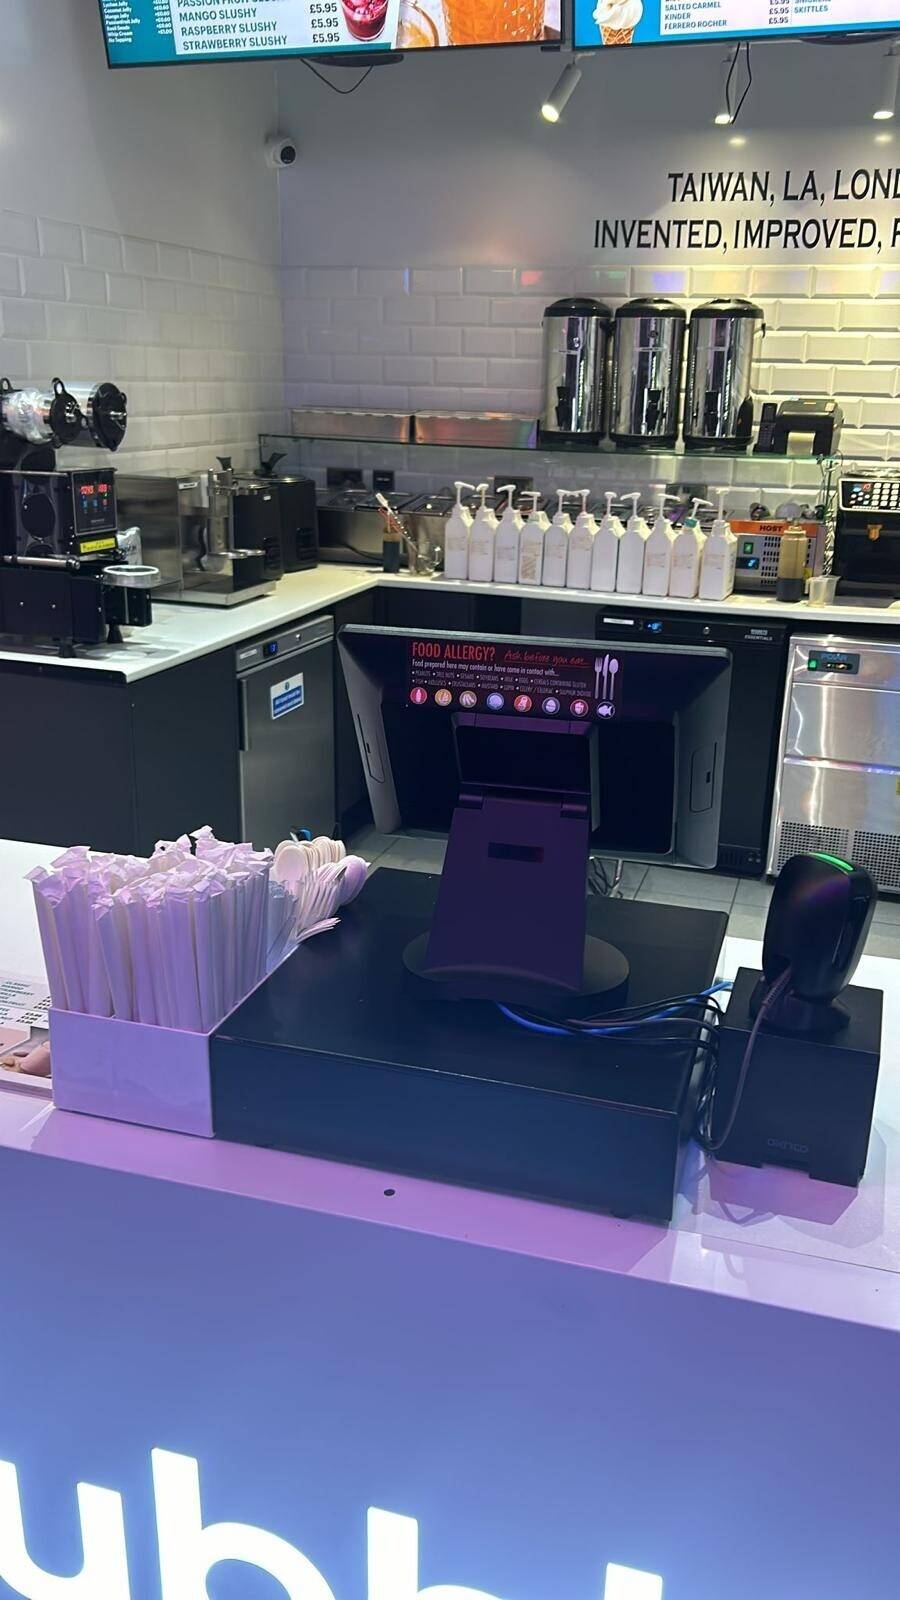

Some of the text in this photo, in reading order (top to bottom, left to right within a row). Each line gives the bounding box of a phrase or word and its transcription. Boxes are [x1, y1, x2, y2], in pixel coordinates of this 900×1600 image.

[310, 3, 337, 14] £5.95
[769, 7, 789, 15] £5.95
[794, 5, 828, 13] SKITTLES
[179, 8, 257, 21] MANGO SLUSHY
[181, 21, 277, 36] RASPBERRY SLUSHY
[311, 18, 339, 28] £5.95
[664, 20, 727, 30] FERRERO ROCHER
[183, 35, 287, 51] STRAWBERRY SLUSHY
[312, 32, 340, 43] £5.95
[668, 171, 774, 206] TAIWAN,
[782, 170, 825, 206] LA,
[593, 219, 727, 254] INVENTED,
[733, 218, 882, 253] IMPROVED,
[412, 642, 441, 658] FOOD
[444, 644, 496, 661] ALLERGY?
[412, 659, 424, 667] Food
[424, 661, 445, 669] prepared
[446, 661, 457, 669] here
